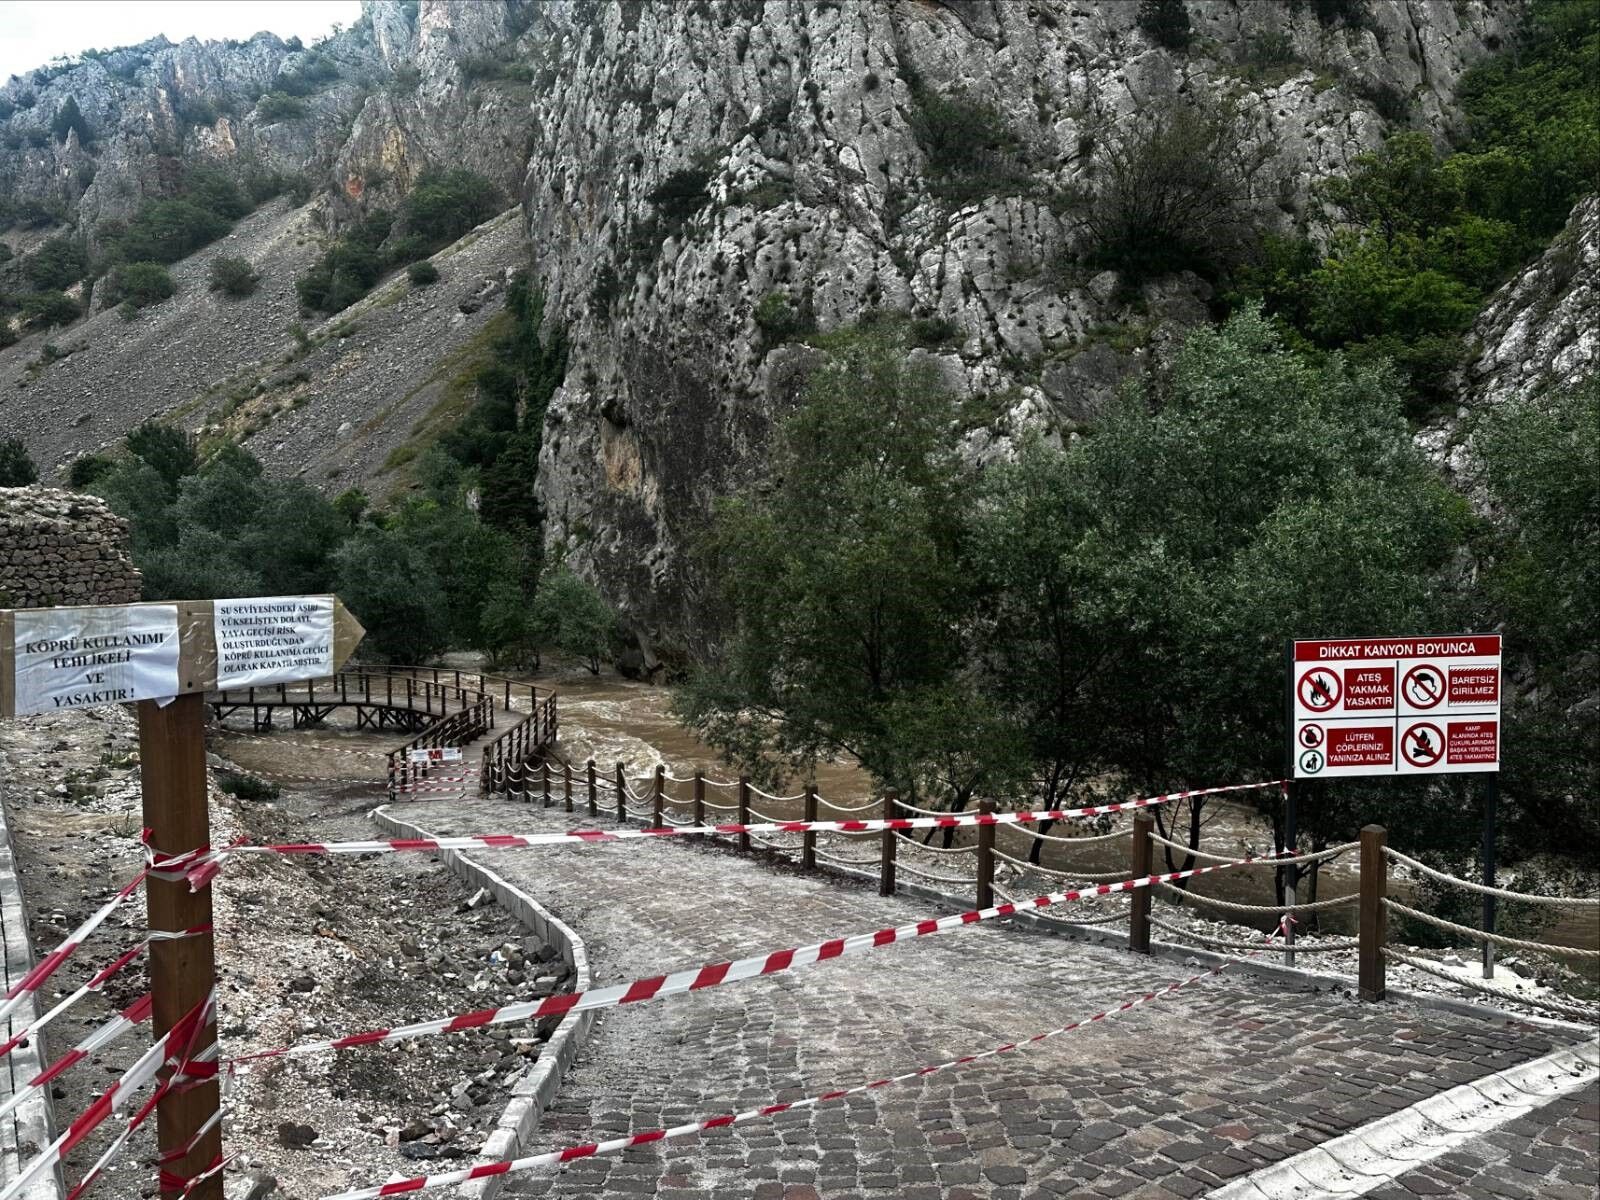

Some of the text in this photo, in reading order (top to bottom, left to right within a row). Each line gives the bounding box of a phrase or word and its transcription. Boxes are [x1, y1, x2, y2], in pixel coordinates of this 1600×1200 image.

[221, 607, 232, 615] SU
[233, 604, 296, 614] SEVİYESİNDEKİ
[221, 616, 278, 626] YÜKSELİŞTEN
[221, 629, 244, 638] YAYA
[277, 626, 296, 634] RİSK
[26, 633, 164, 654] KÖPRÜ KULLANIMI
[222, 637, 305, 650] OLUŞTURDUĞUNDAN
[224, 645, 329, 662] KÖPRÜ KULLANIMA GEÇİCİ
[1319, 642, 1476, 658] DİKKAT KANYON BOYUNCA
[53, 651, 131, 669] TEHLİKELİ
[224, 661, 259, 673] OLARAK
[86, 672, 105, 684] VE
[1356, 672, 1382, 684] ATEŞ
[1452, 674, 1495, 684] BARETSİZ
[1349, 684, 1390, 694] YAKMAK
[1452, 685, 1494, 696] GİRİLMEZ
[1346, 696, 1393, 706] YASAKTIR
[1345, 732, 1375, 742] LÜTFEN
[1329, 752, 1390, 762] YANINIZA ALINIZ
